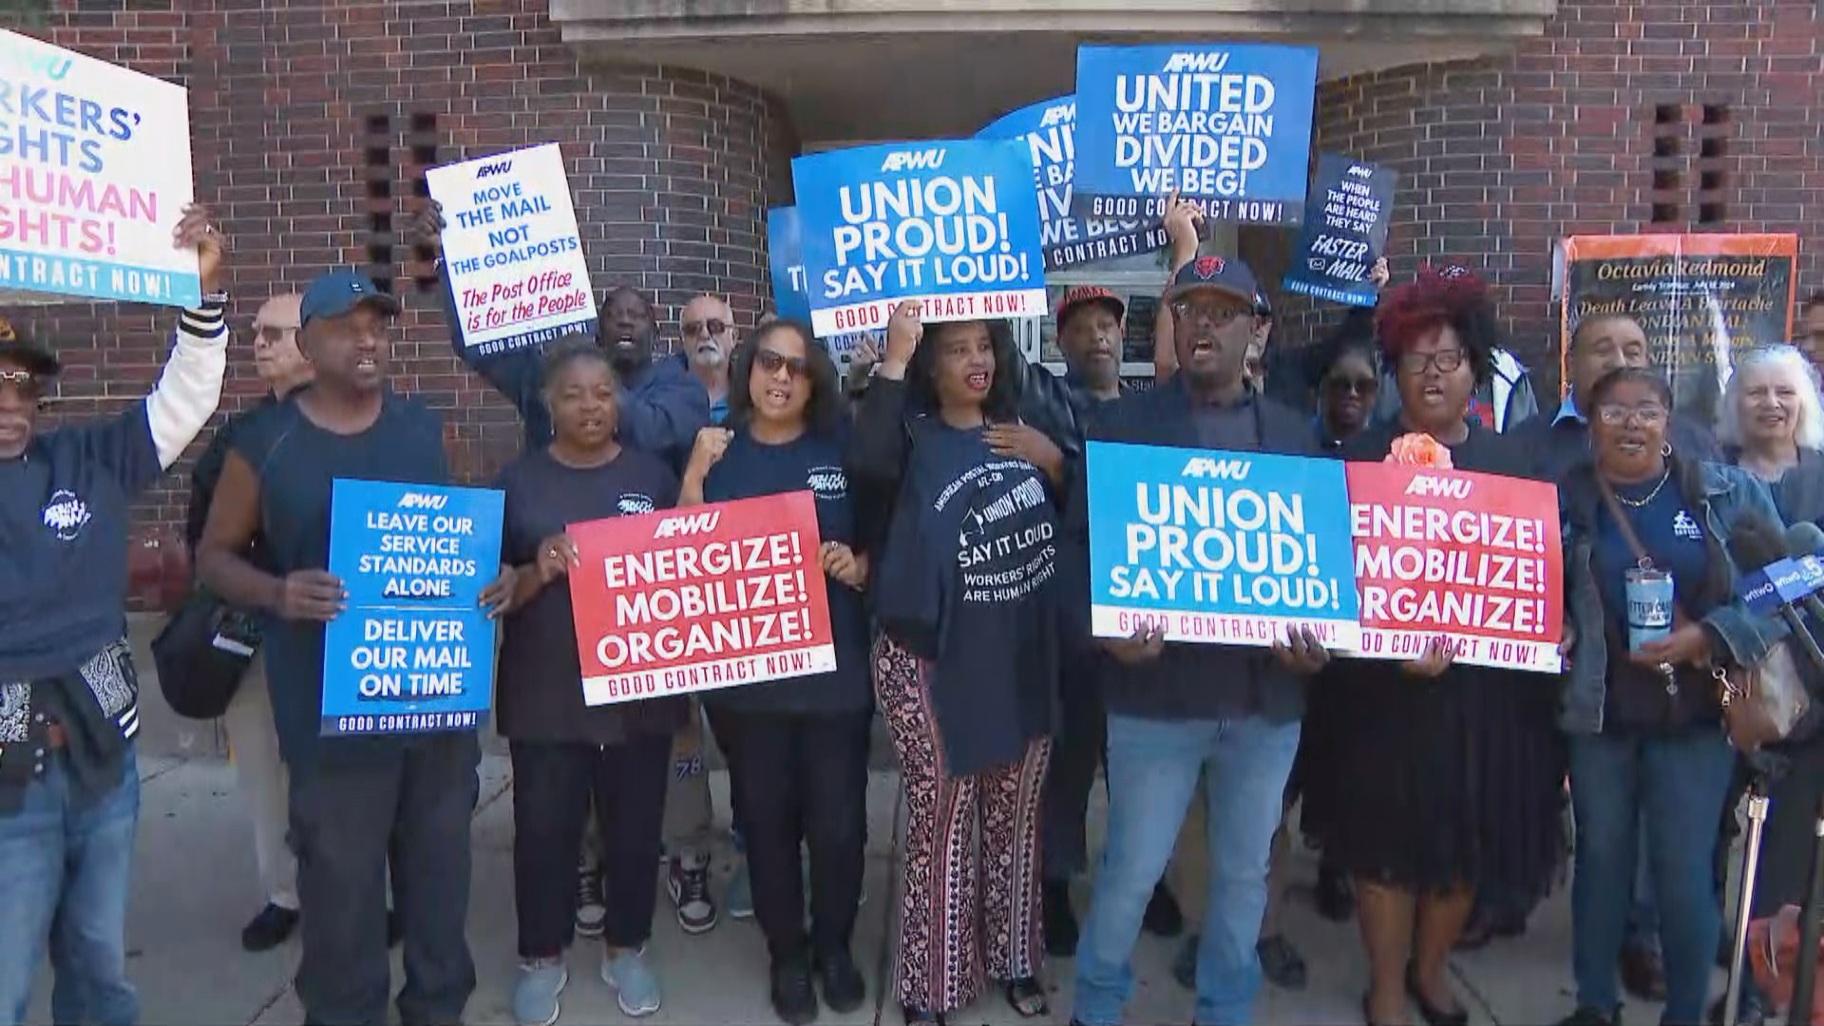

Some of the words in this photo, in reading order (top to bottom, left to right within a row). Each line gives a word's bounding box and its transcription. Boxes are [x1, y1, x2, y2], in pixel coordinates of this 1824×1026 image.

[1163, 52, 1229, 73] APWU
[1116, 74, 1275, 113] UNITED
[1113, 112, 1151, 134] WE
[1158, 112, 1273, 137] BARGAIN
[882, 149, 946, 172] APWU
[1115, 134, 1268, 170] DIVIDED
[476, 160, 512, 178] APWU
[1131, 168, 1173, 193] WE
[1182, 168, 1246, 196] BEG!
[0, 165, 157, 223] HUMAN
[474, 182, 522, 205] MOVE
[840, 176, 997, 224] UNION
[1327, 189, 1346, 203] THE
[1346, 194, 1380, 212] PEOPLE
[1341, 180, 1370, 197] WHEN
[456, 206, 495, 229] THE
[501, 195, 551, 220] MAIL
[1093, 198, 1137, 216] GOOD
[1145, 198, 1230, 219] COACT
[1239, 202, 1283, 222] NOW!
[1325, 202, 1346, 215] ARE
[1346, 206, 1377, 223] HEARD
[1326, 214, 1352, 230] THEY
[1352, 222, 1373, 234] SAY
[488, 224, 529, 248] NOT
[833, 212, 1011, 266] PROUD!
[1053, 234, 1137, 266] CONTRACT
[1311, 234, 1368, 262] FASTER
[451, 257, 480, 275] THE
[484, 236, 577, 268] GOALPOSTS
[1598, 260, 1674, 281] Octavia
[1677, 258, 1766, 277] Redmond
[112, 268, 172, 298] NOW!
[824, 261, 888, 298] SAY
[898, 258, 925, 288] IT
[935, 252, 1029, 285] LOUD!
[1325, 258, 1367, 282] MAIL
[463, 289, 487, 308] The
[492, 280, 523, 302] Post
[528, 269, 572, 294] Office
[467, 309, 480, 330] is
[486, 305, 507, 325] for
[512, 300, 534, 320] the
[539, 288, 586, 314] People
[835, 305, 880, 329] GOOD
[984, 294, 1027, 315] NOW!
[1581, 297, 1625, 316] Death
[479, 338, 504, 355] GOOD
[508, 328, 558, 348] CONTRACT
[1182, 457, 1251, 480] APWU
[983, 492, 1016, 523] UNION
[1011, 476, 1046, 511] PROUD
[1405, 474, 1472, 499] APWU
[398, 492, 448, 510] APWU
[1136, 482, 1305, 534] UNION
[367, 512, 428, 533] LEAVE
[433, 516, 473, 535] OUR
[654, 511, 720, 539] APWU
[1351, 503, 1545, 553] ENERGIZE!
[380, 535, 460, 555] SERVICE
[957, 541, 992, 568] SAY
[996, 535, 1011, 557] IT
[1015, 522, 1053, 550] LOUD
[1126, 523, 1320, 577] PROUD!
[359, 555, 476, 576] STANDARDS
[604, 531, 804, 589] ENERGIZE!
[964, 565, 1026, 586] WORKERS'
[1027, 545, 1056, 575] RIGHTS
[1355, 544, 1545, 593] MOBILIZE!
[384, 579, 451, 598] ALONE
[616, 569, 808, 627] MOBILIZE!
[963, 590, 991, 602] ARE
[994, 580, 1031, 602] HUMAN
[1109, 566, 1184, 600] SAY
[1193, 571, 1223, 603] IT
[1233, 573, 1340, 610] LOUD!
[1356, 586, 1545, 634] RGANIZE!
[365, 619, 464, 641] DELIVER
[597, 607, 813, 669] ORGANIZE!
[1119, 611, 1168, 634] GOOD
[1181, 616, 1277, 640] CONTRACT
[351, 647, 408, 670] OUR
[414, 646, 472, 669] MAIL
[1489, 641, 1538, 664] NOW!
[359, 674, 400, 697] ON
[409, 673, 463, 695] TIME
[608, 676, 655, 697] GOOD
[665, 659, 757, 690] CONTRACT
[766, 652, 813, 674] NOW!
[339, 716, 374, 732] GOOD
[379, 713, 442, 730] CONTRACT
[447, 712, 477, 728] NOW!
